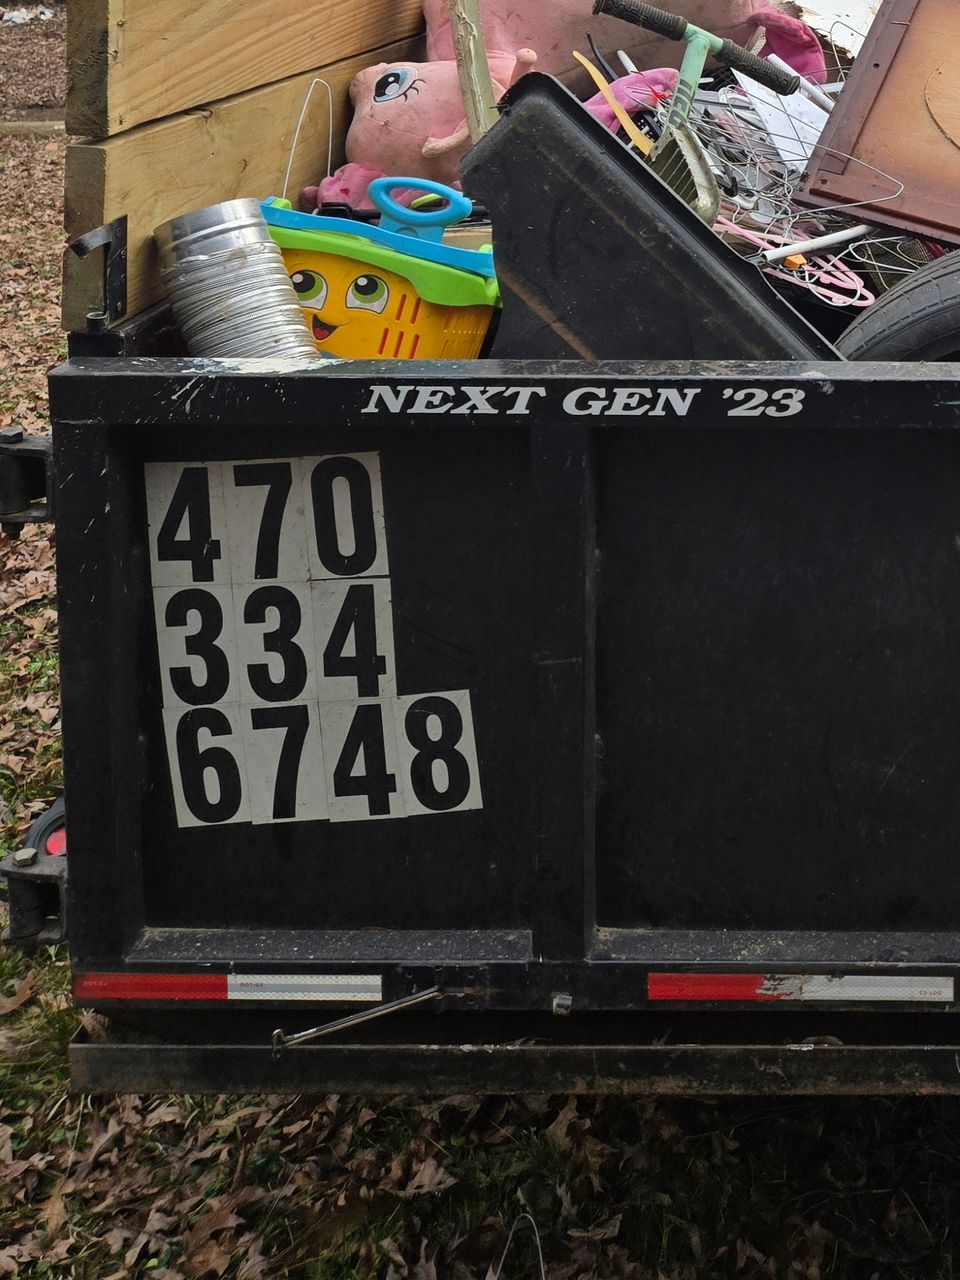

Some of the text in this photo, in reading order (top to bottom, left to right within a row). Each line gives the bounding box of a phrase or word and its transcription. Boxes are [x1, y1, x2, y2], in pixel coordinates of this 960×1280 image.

[360, 385, 548, 415] NEXT
[562, 386, 701, 416] GEN
[157, 456, 378, 583] 470
[165, 584, 387, 706] 334
[176, 695, 471, 824] 6748
